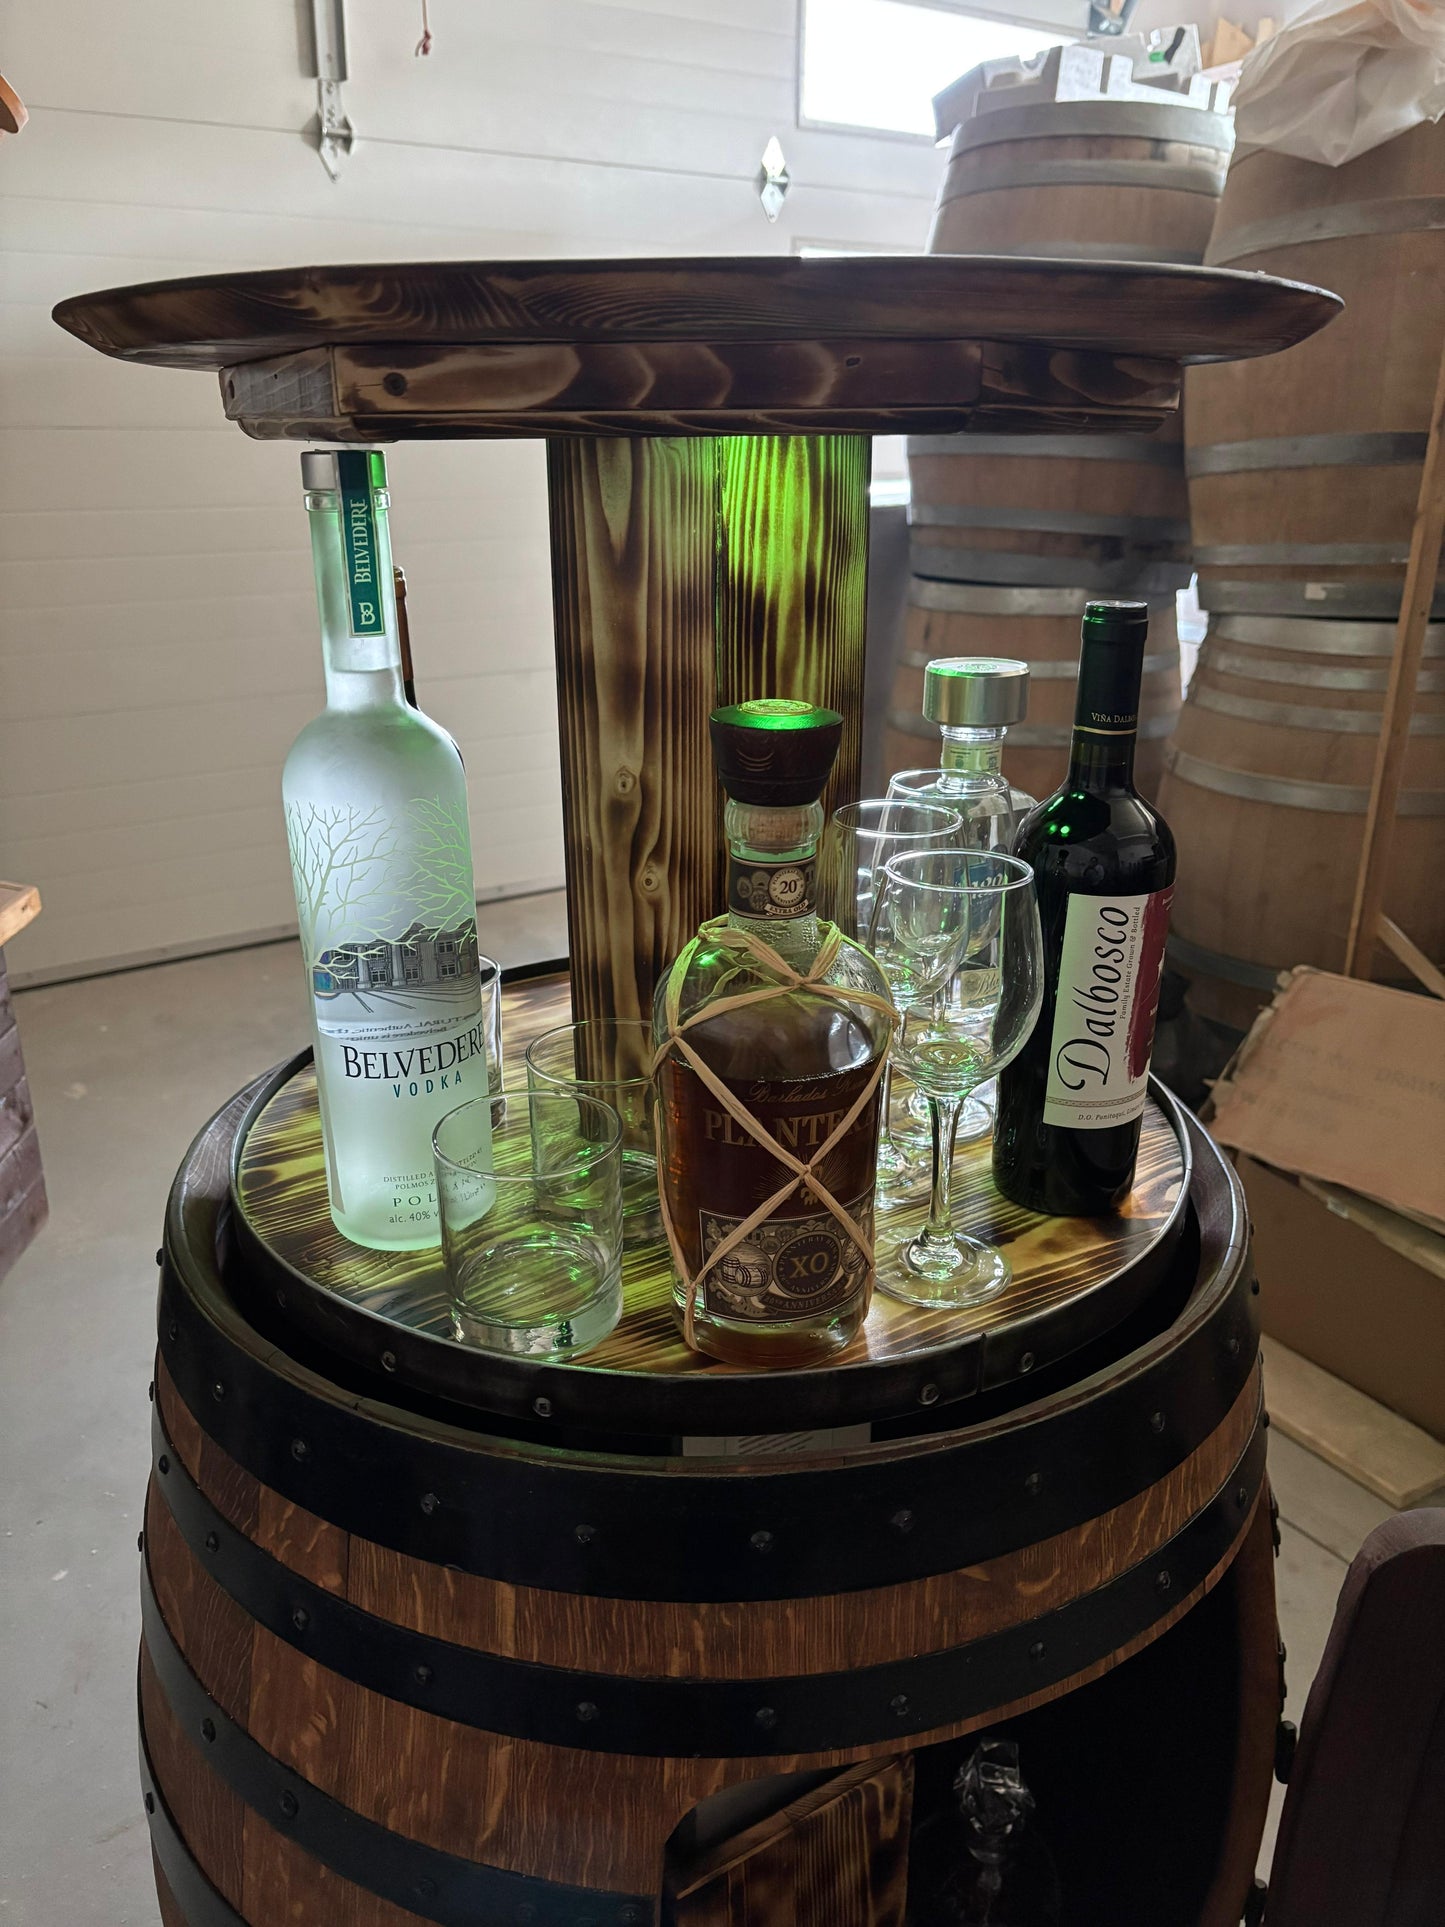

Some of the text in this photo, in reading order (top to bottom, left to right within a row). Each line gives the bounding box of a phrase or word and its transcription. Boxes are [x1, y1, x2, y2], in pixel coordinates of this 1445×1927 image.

[350, 498, 373, 584] BELVEDERE
[1091, 712, 1111, 723] VIÑA
[779, 879, 798, 895] 20
[793, 902, 806, 912] OLD
[1131, 906, 1141, 933] Bottled
[1127, 943, 1136, 969] Grown
[1123, 970, 1133, 993] Estate
[1056, 906, 1130, 1091] Dalbosco
[1119, 994, 1131, 1020] Family
[339, 1020, 485, 1080] BELVEDERE
[392, 1070, 463, 1098] VODKA
[383, 1172, 427, 1183] DISTILLED
[395, 1181, 429, 1191] POLMOS
[389, 1214, 407, 1224] alc.
[409, 1210, 431, 1222] 40%
[789, 1252, 830, 1279] XO
